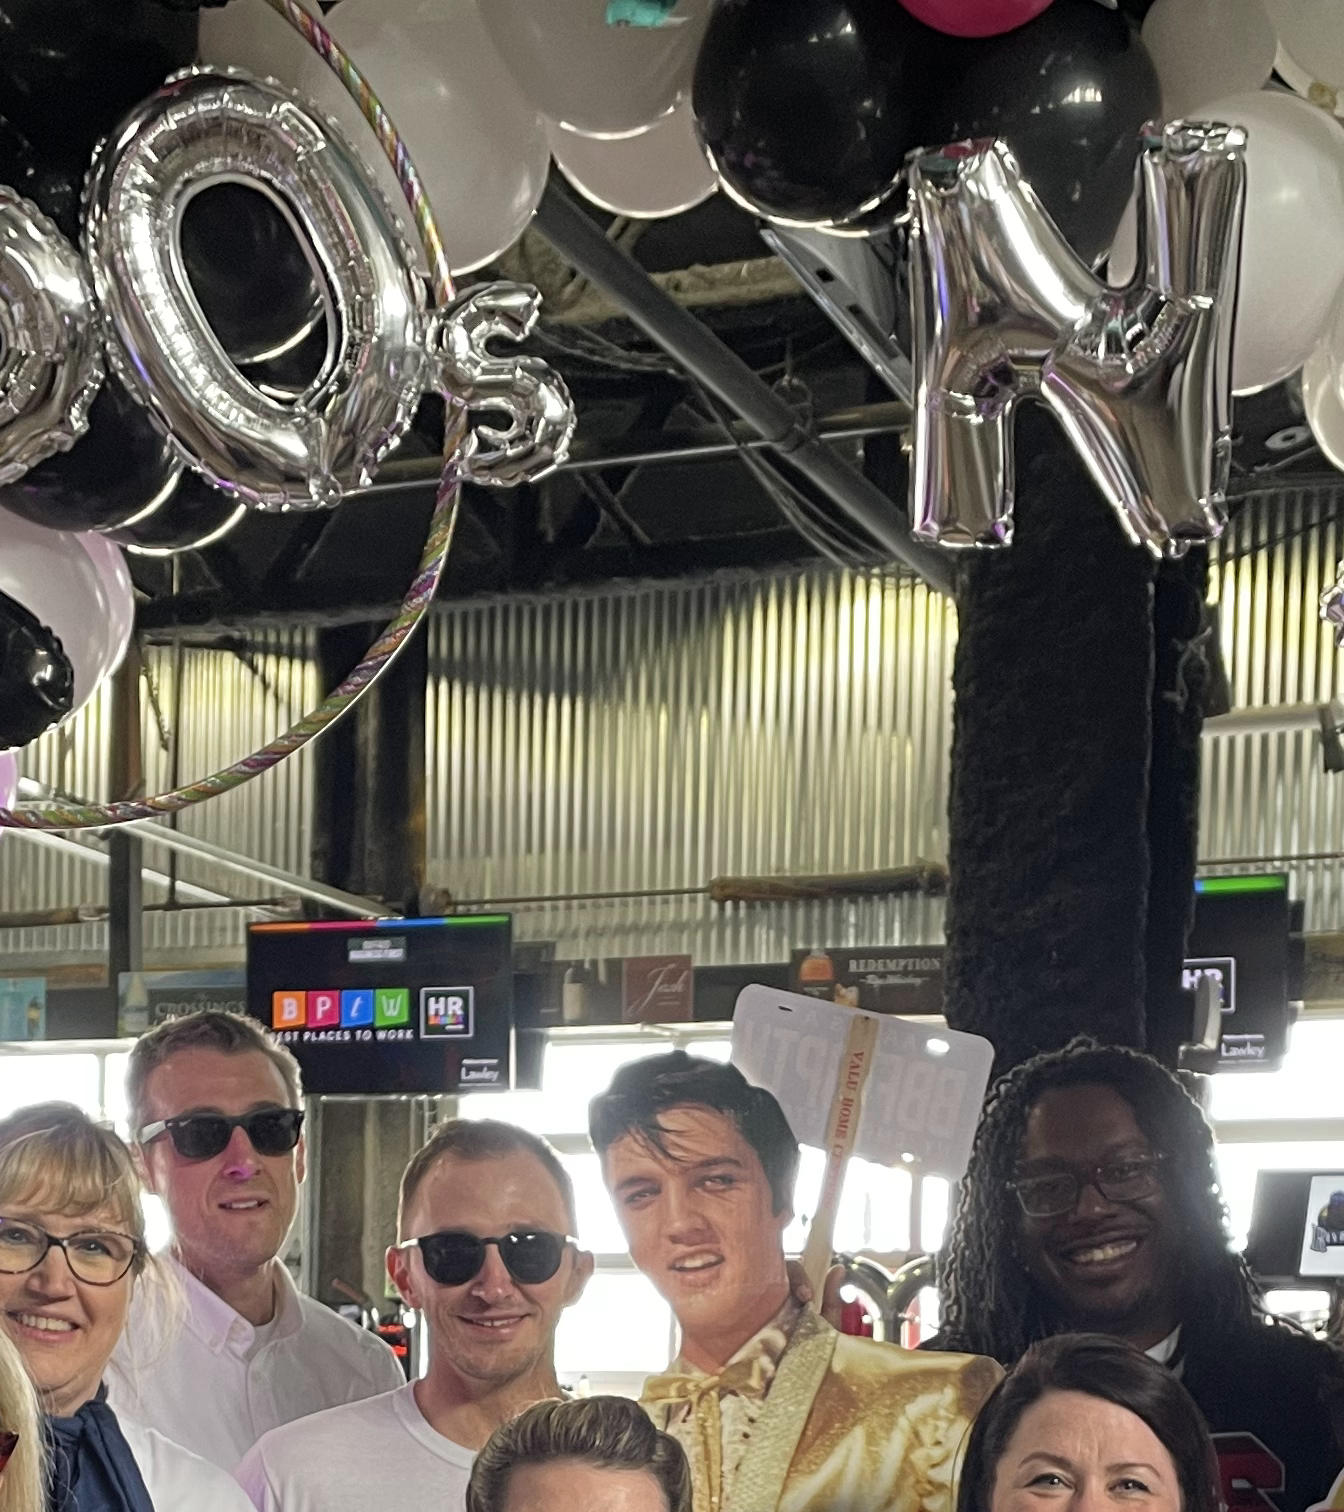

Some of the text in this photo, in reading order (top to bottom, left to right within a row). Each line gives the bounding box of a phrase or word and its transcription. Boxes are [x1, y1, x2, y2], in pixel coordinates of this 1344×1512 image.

[904, 118, 1249, 560] N
[847, 957, 941, 973] REDEMPTION
[428, 996, 464, 1016] HR
[303, 1029, 351, 1042] PLACES
[355, 1029, 372, 1041] TO
[376, 1027, 414, 1041] WORK
[1220, 1040, 1265, 1059] Lawley
